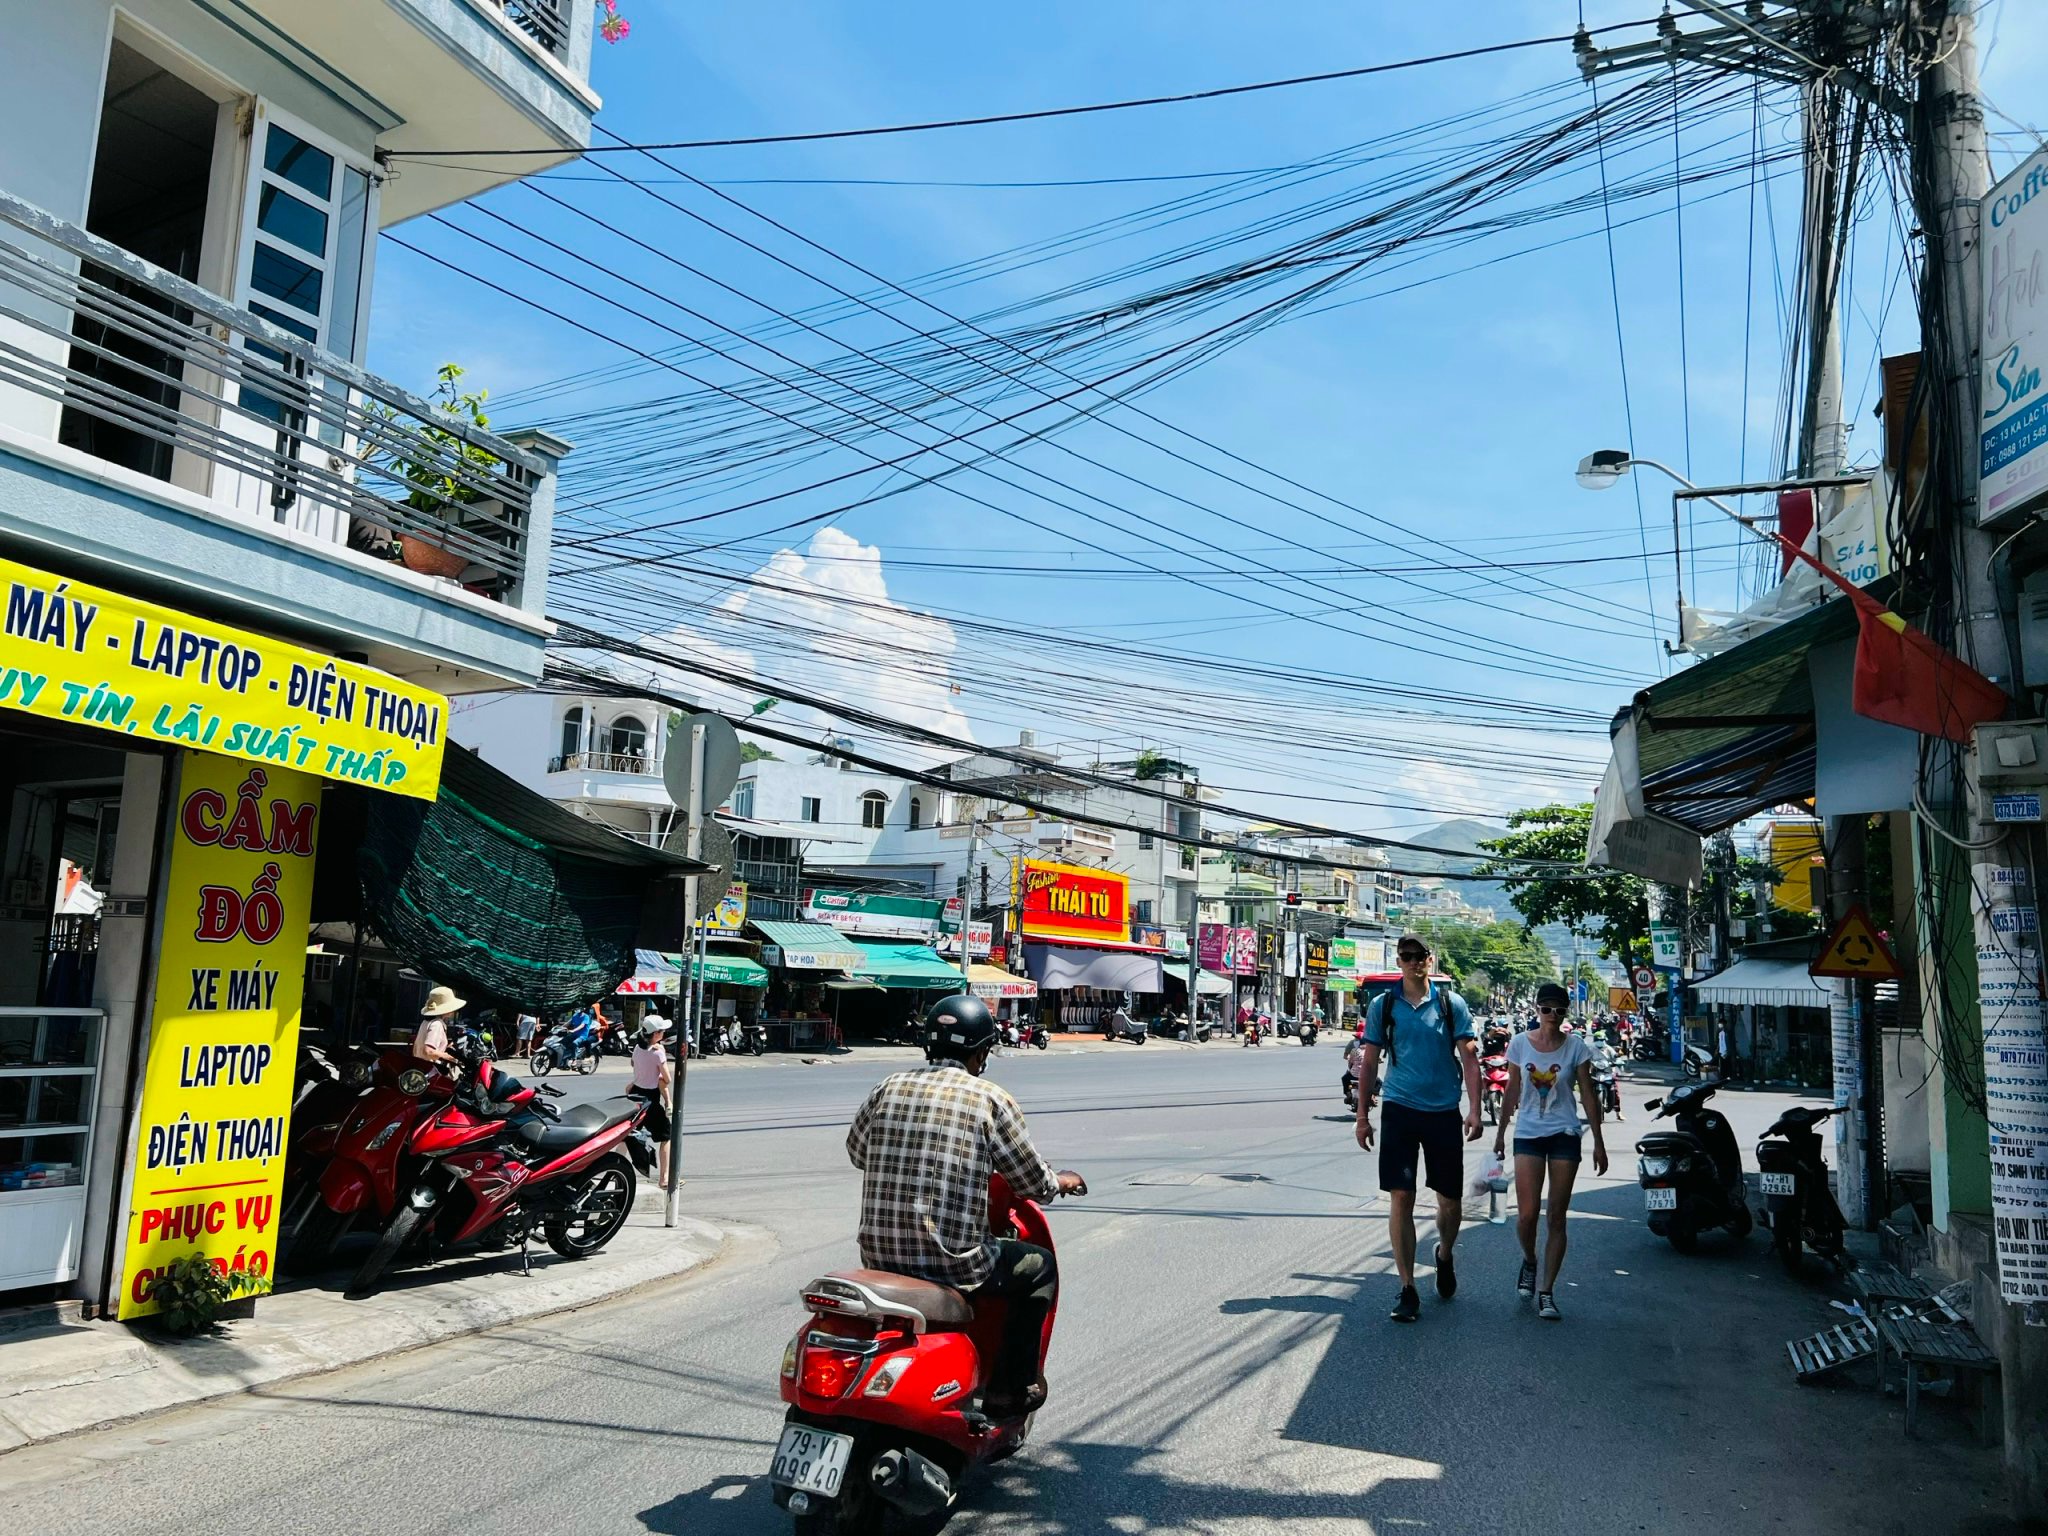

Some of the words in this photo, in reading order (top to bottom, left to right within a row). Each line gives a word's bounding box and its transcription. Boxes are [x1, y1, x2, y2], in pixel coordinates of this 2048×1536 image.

[1998, 442, 2016, 462] 0988
[2018, 433, 2031, 449] 121
[2032, 424, 2047, 441] 549
[2000, 428, 2009, 441] 13
[5, 582, 98, 654] MÁY
[130, 618, 262, 695] LAPTOP
[287, 662, 357, 727] ĐIỆN
[364, 687, 440, 750] THOẠI
[61, 681, 138, 735] TÍN,
[152, 703, 220, 746] LÃI
[223, 722, 317, 766] SUẤT
[324, 749, 408, 787] THẤP
[182, 768, 317, 857] CẦM
[1026, 870, 1061, 893] Fashion
[194, 862, 285, 945] ĐỒ
[1661, 943, 1676, 955] 82
[187, 968, 221, 1011] XE
[226, 959, 280, 1011] MÁY
[1638, 973, 1649, 983] 40
[180, 1044, 272, 1089] LAPTOP
[147, 1111, 209, 1176] ĐIỆN
[216, 1116, 284, 1167] THOẠI
[2000, 1145, 2035, 1158] THUÊ
[2007, 1163, 2028, 1179] SINH
[2009, 1198, 2029, 1207] 757
[139, 1200, 226, 1244] PHỤC
[235, 1194, 273, 1234] VỤ
[2012, 1218, 2030, 1240] VAY
[2021, 1284, 2039, 1297] 404
